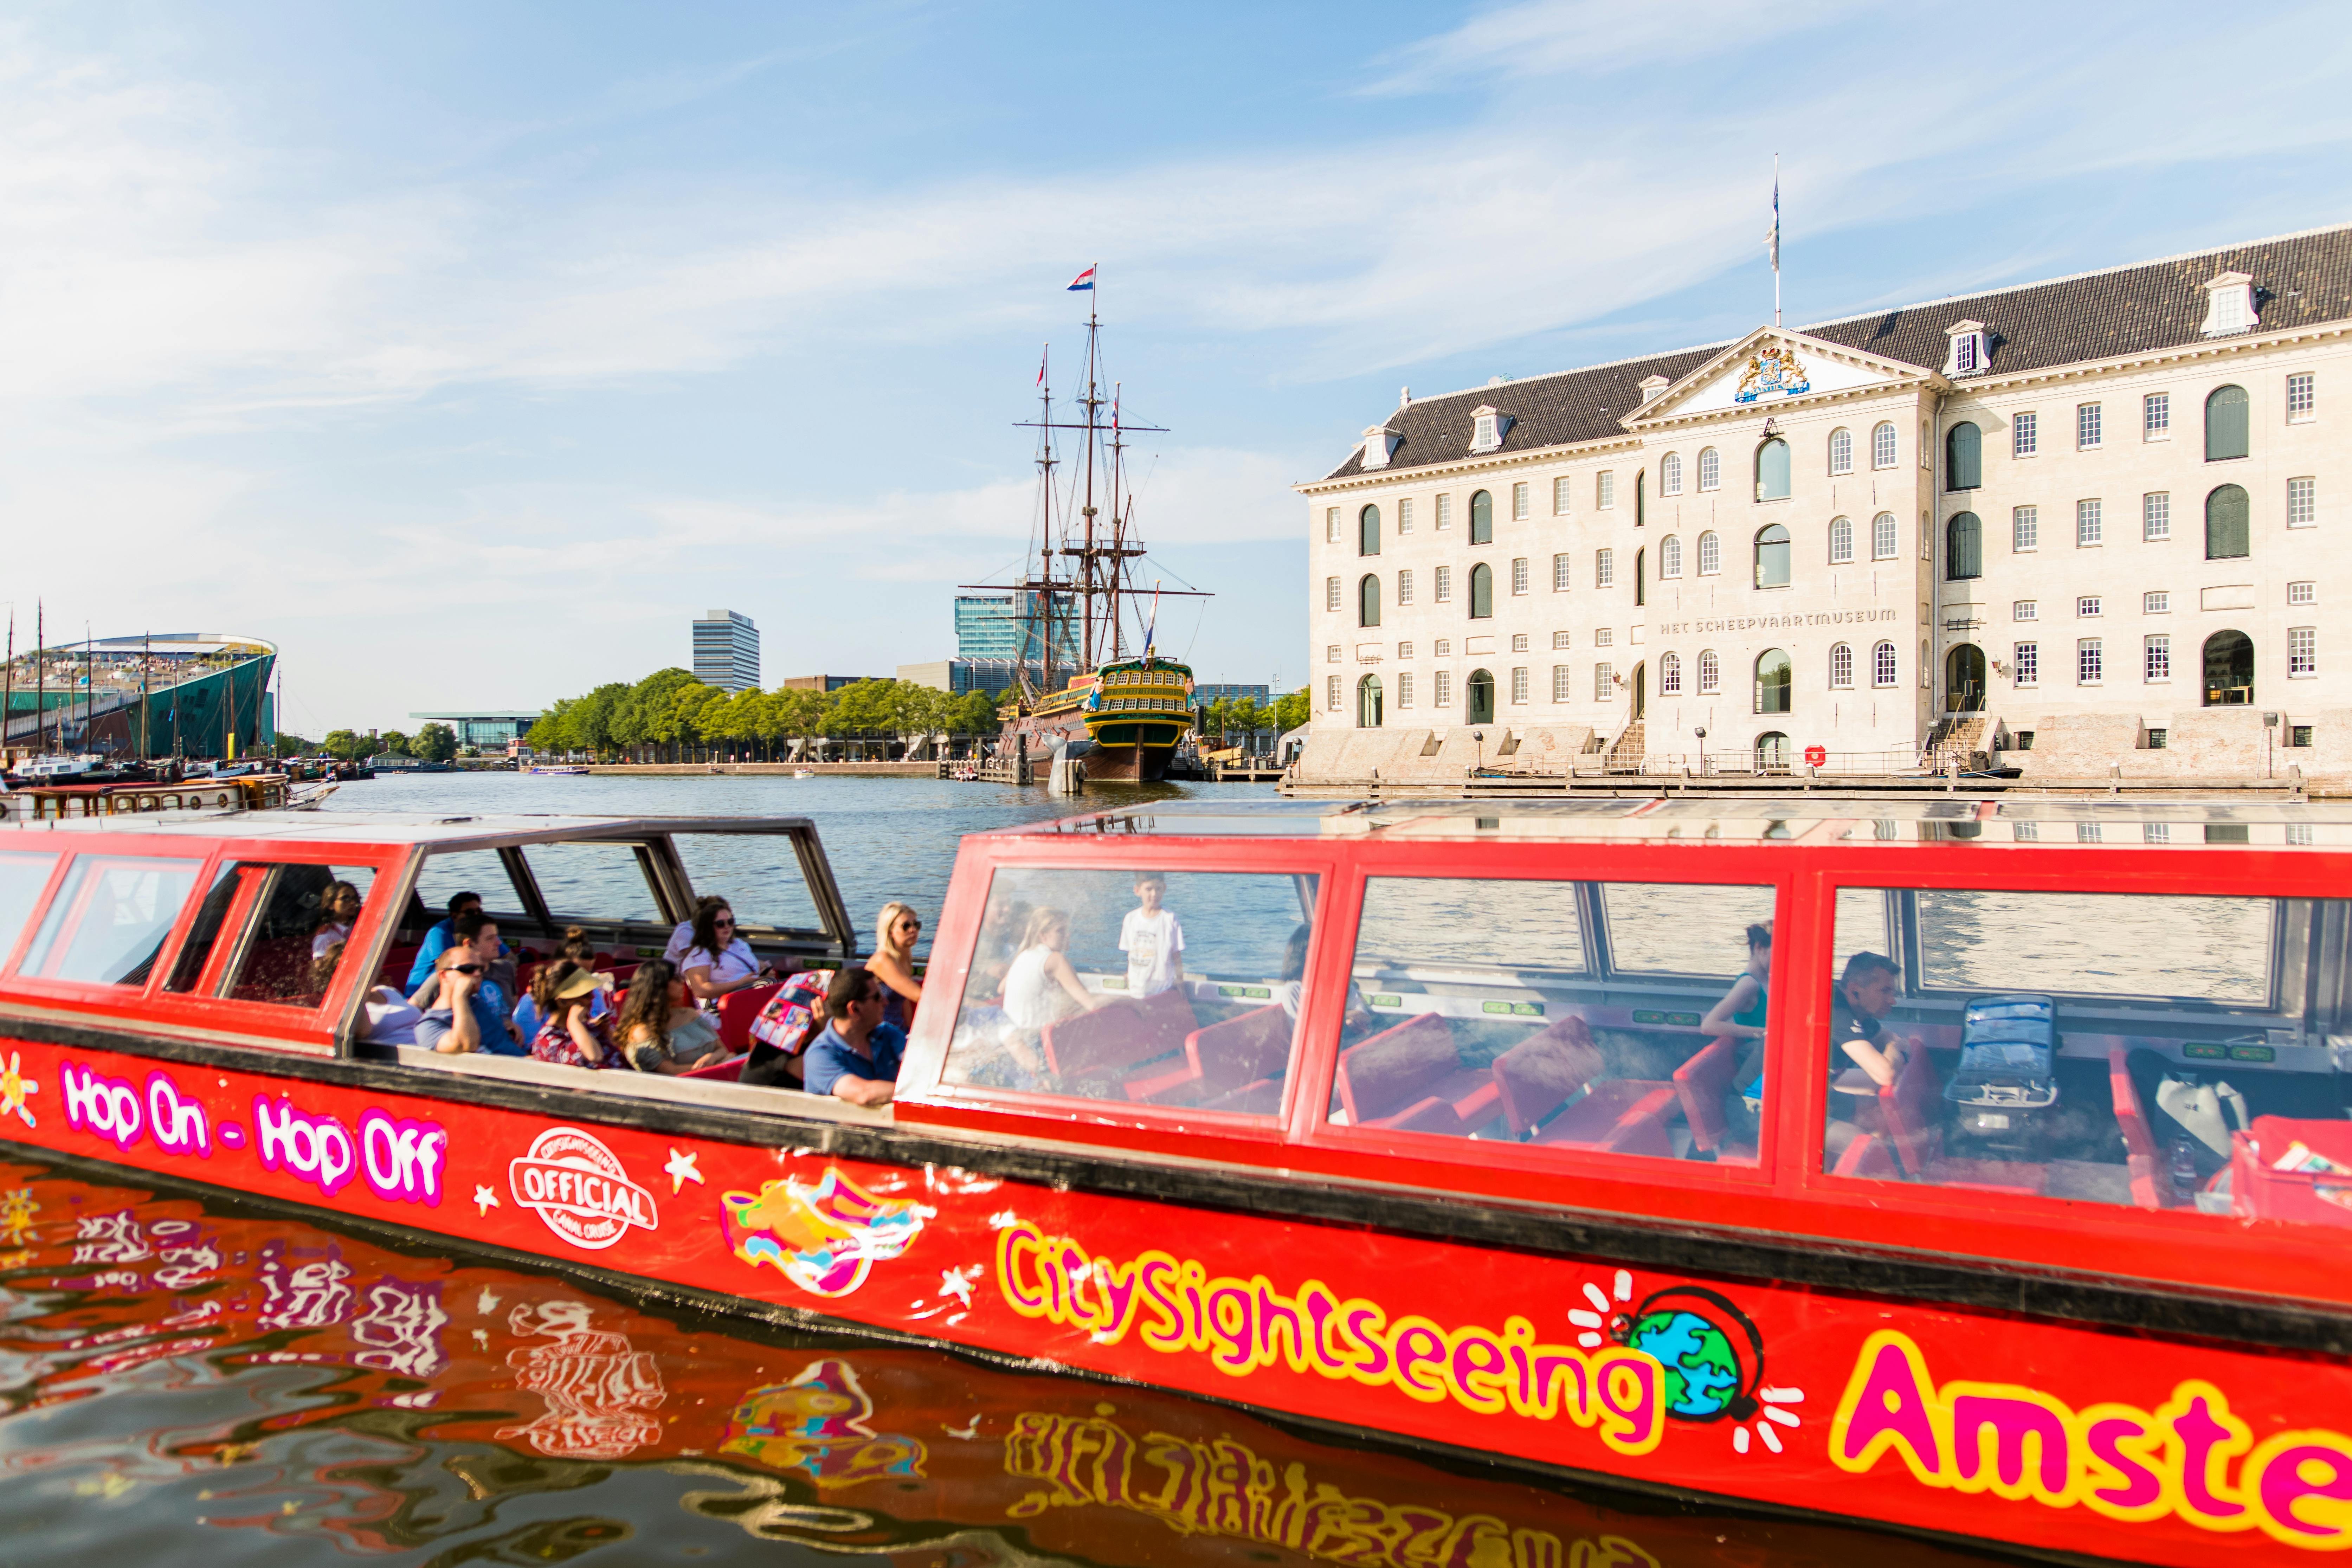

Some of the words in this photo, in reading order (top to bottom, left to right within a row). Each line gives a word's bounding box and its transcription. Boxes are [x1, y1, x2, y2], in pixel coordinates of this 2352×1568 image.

[1660, 622, 1688, 634] HET
[1696, 608, 1896, 632] SCHEEPVAARTMUSEUM
[63, 1067, 141, 1144] Hop
[148, 1078, 207, 1149] On
[257, 1103, 352, 1187] Hop
[362, 1116, 442, 1197] Off
[523, 1167, 649, 1223] OFFICIAL
[553, 1209, 584, 1238] CANAL
[583, 1218, 618, 1239] CRUISE
[1838, 1337, 2352, 1541] Amste
